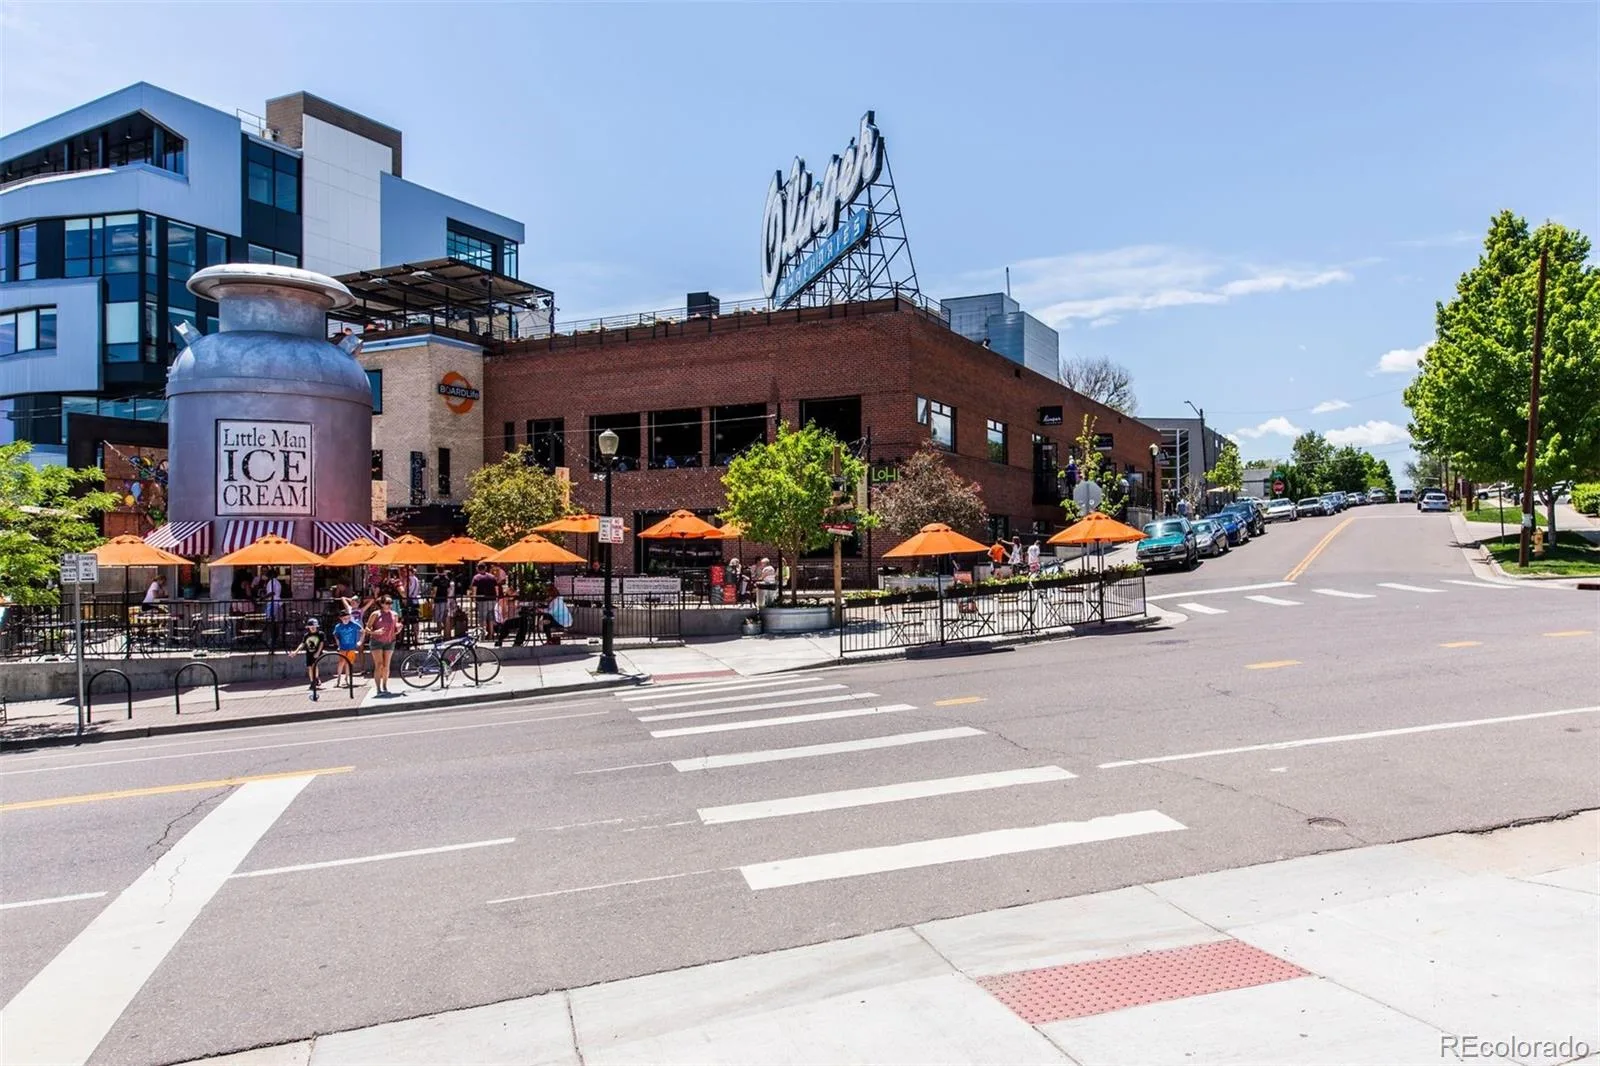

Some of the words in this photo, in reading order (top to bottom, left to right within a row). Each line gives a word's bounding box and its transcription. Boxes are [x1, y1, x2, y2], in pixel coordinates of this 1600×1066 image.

[223, 427, 266, 447] Little
[271, 429, 307, 448] Man
[223, 449, 307, 483] ICE
[223, 484, 308, 507] CREAM
